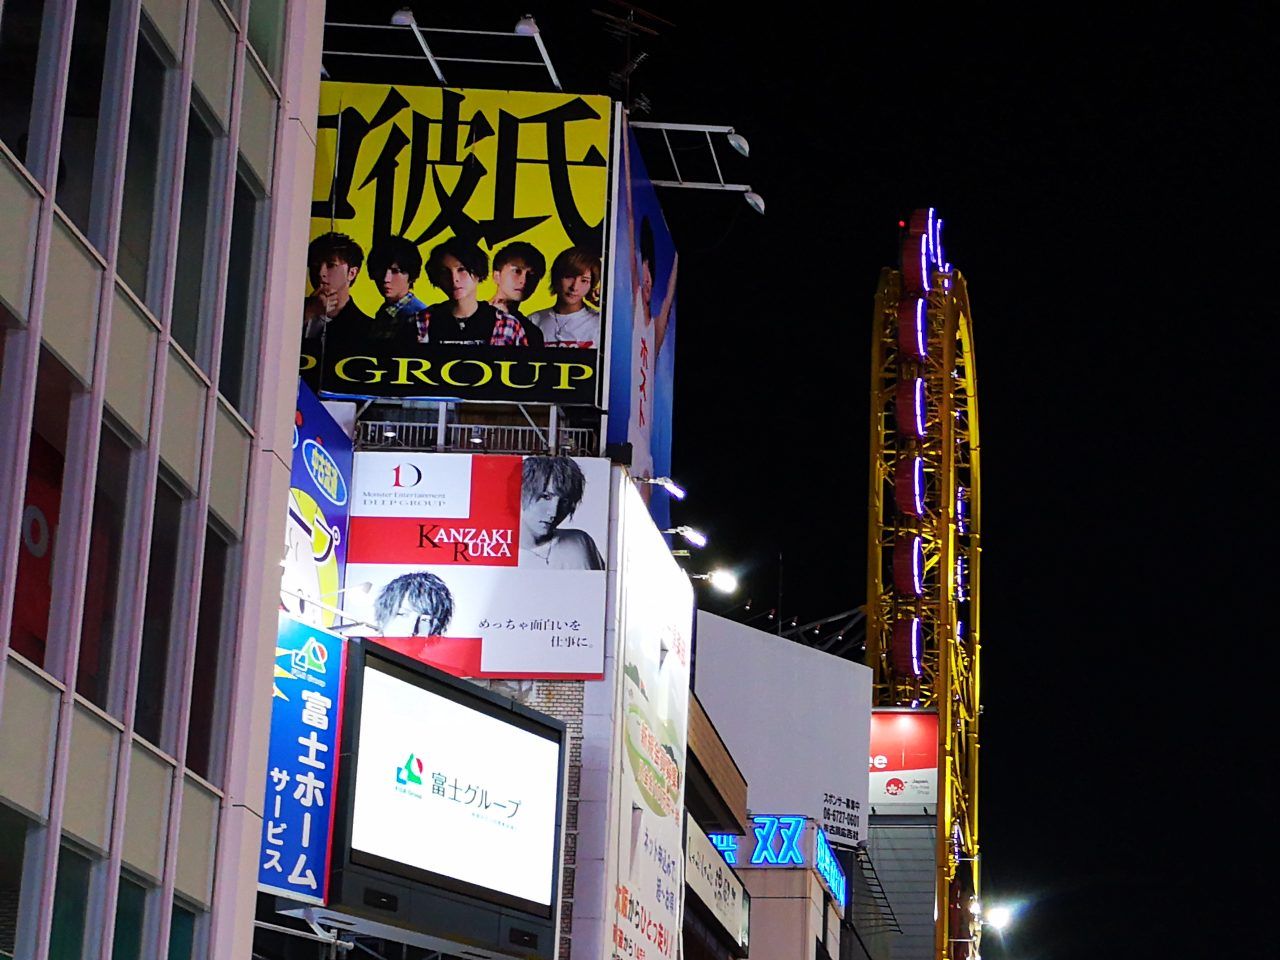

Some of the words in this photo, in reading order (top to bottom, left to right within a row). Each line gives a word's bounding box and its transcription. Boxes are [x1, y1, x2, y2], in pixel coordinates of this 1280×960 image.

[334, 355, 595, 391] GROUP
[418, 524, 513, 548] KANZAKI
[453, 541, 512, 562] RUKA
[479, 618, 581, 632] めっちゃ面白いを
[287, 689, 332, 890] 富士ホーム
[432, 771, 522, 818] 富士グループ
[263, 767, 290, 873] サービス
